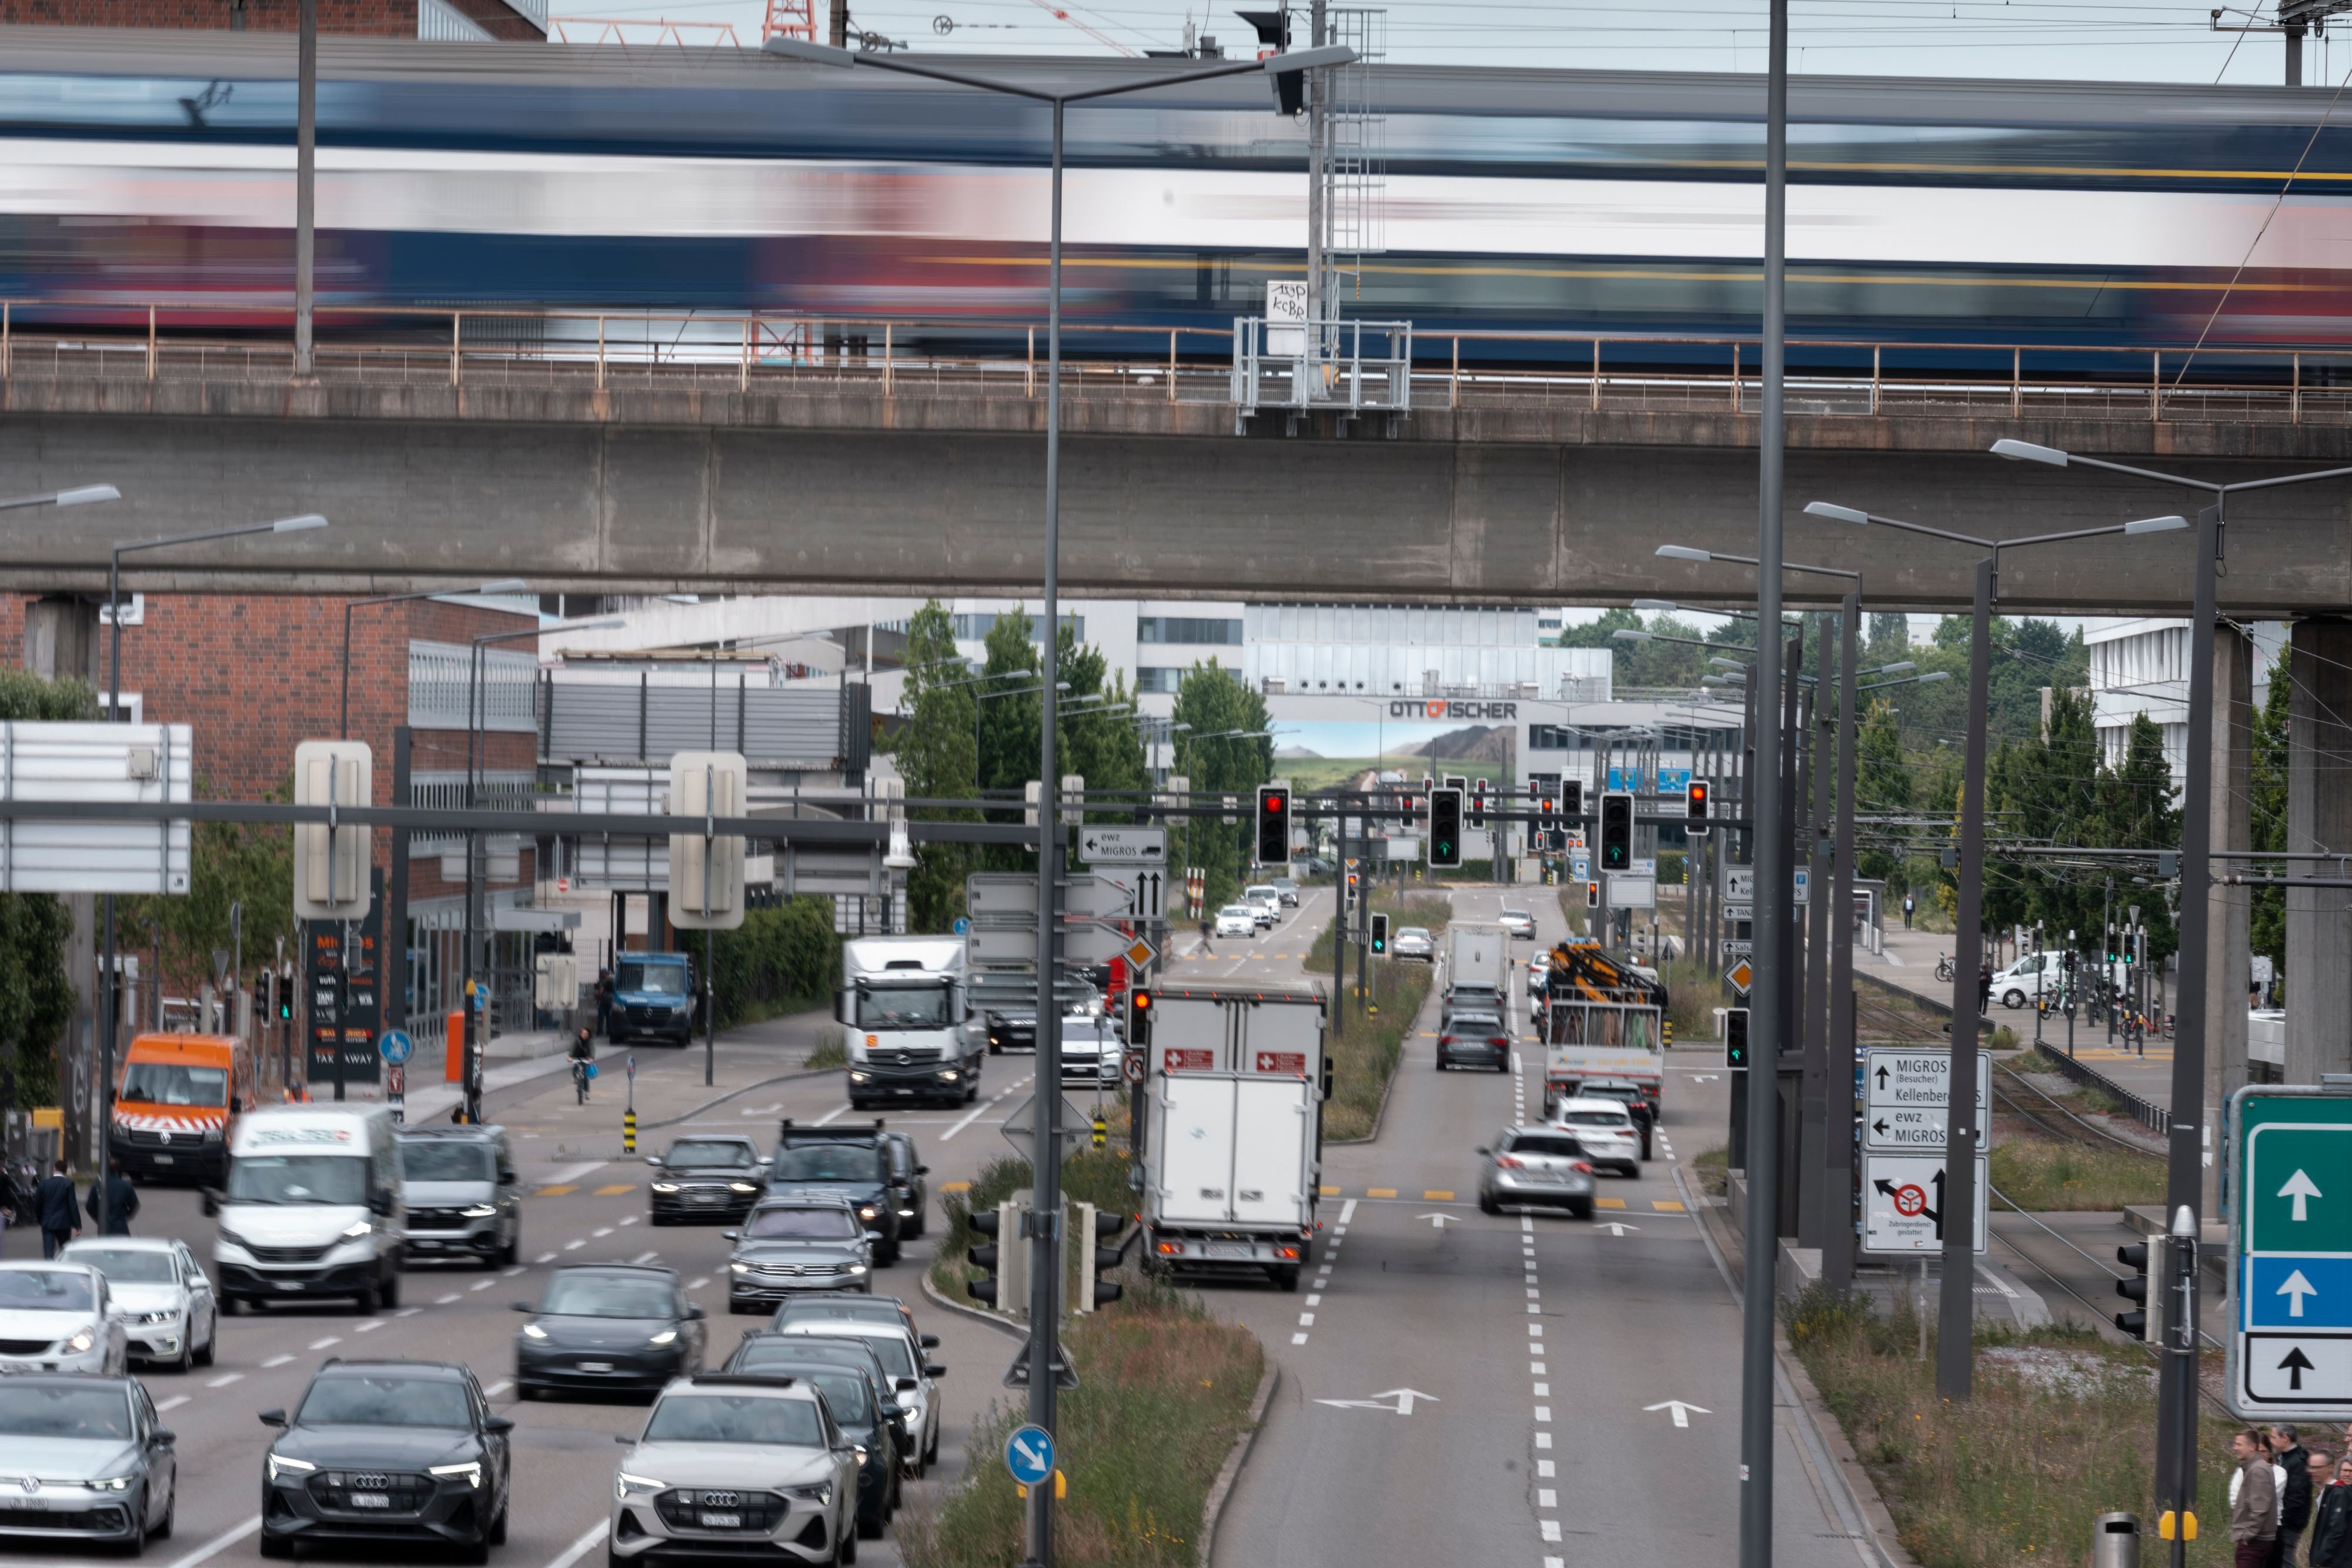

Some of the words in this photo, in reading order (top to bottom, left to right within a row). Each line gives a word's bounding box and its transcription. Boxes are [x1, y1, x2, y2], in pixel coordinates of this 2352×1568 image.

[1101, 846, 1137, 856] MIGROS
[1897, 1060, 1947, 1072] MIGROS
[1896, 1074, 1938, 1084] (Besucher)
[1896, 1113, 1922, 1122] ewz
[1895, 1129, 1946, 1142] MIGROS
[1889, 1220, 1931, 1228] Zubringerdienst
